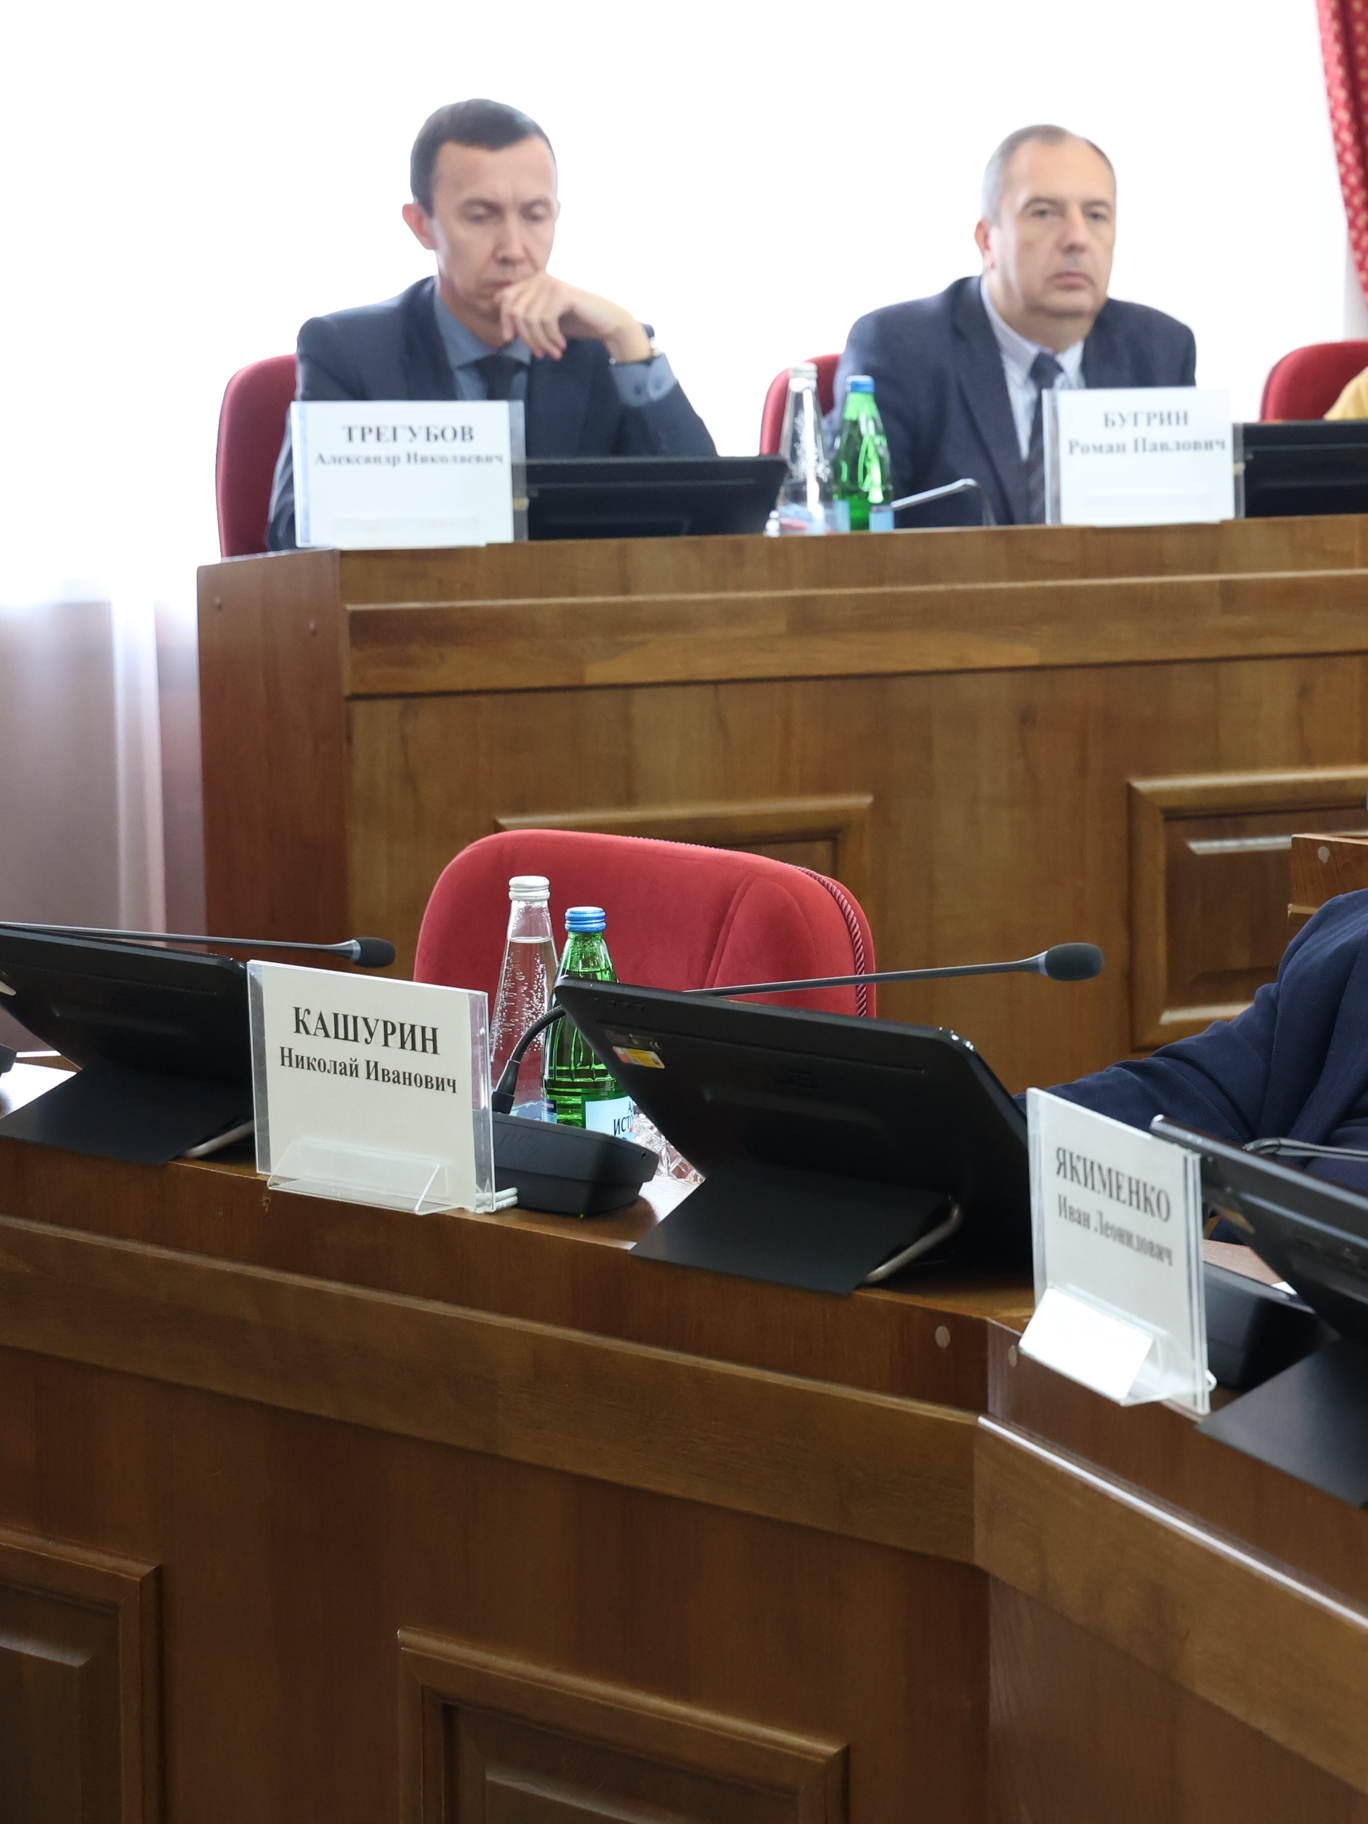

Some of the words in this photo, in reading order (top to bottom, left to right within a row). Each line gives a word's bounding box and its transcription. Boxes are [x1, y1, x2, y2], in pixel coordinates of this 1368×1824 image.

[342, 424, 475, 444] ТРЕГУБОВ
[1103, 410, 1189, 428] БУГРИН
[315, 451, 401, 468] Александр
[405, 451, 504, 466] Николаевич
[1068, 437, 1127, 455] Роман
[1133, 437, 1226, 453] Павлович
[292, 1006, 440, 1055] КАШУРИН
[279, 1046, 360, 1079] Николай
[364, 1059, 457, 1094] Иванович
[1055, 1146, 1171, 1223] ЯКИМЕНКО
[1058, 1193, 1091, 1230] Иван
[1094, 1209, 1173, 1267] Леонидович
